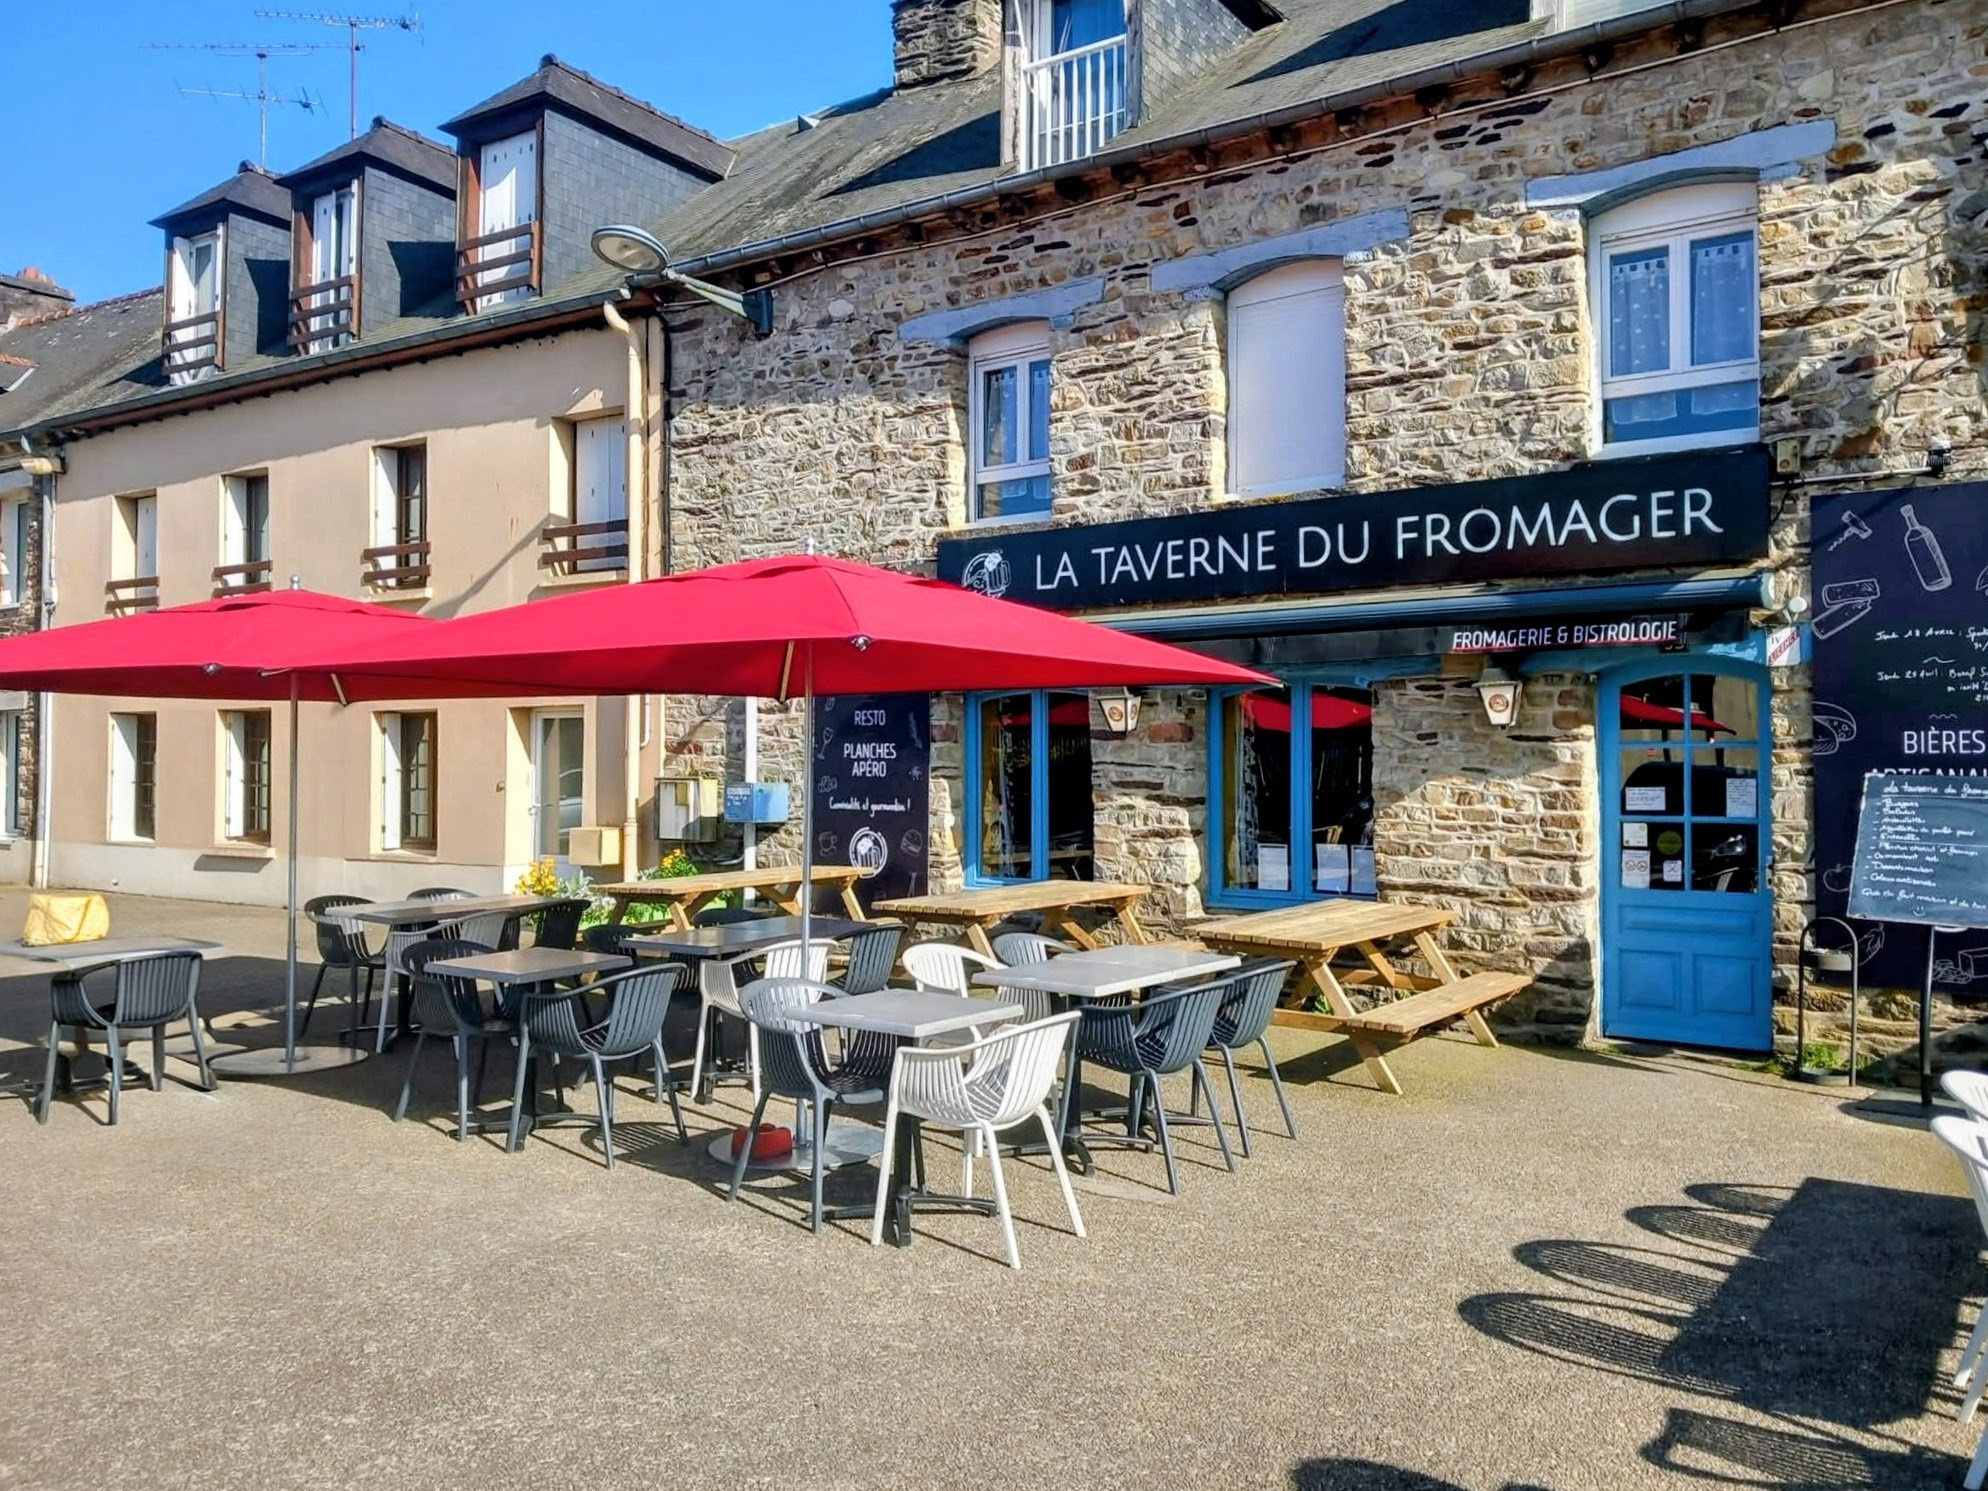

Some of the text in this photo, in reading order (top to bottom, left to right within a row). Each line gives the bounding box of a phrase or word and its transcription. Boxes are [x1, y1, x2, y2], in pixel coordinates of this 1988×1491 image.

[1036, 487, 1725, 591] LA TAVERNE DU FROMAGER
[1452, 620, 1678, 649] FROMAGERIE & BISTROLOGIE
[854, 710, 886, 726] RESTO
[844, 743, 897, 759] PLANCHES
[1904, 725, 1986, 754] BIÈRES
[851, 758, 887, 777] APÉRO
